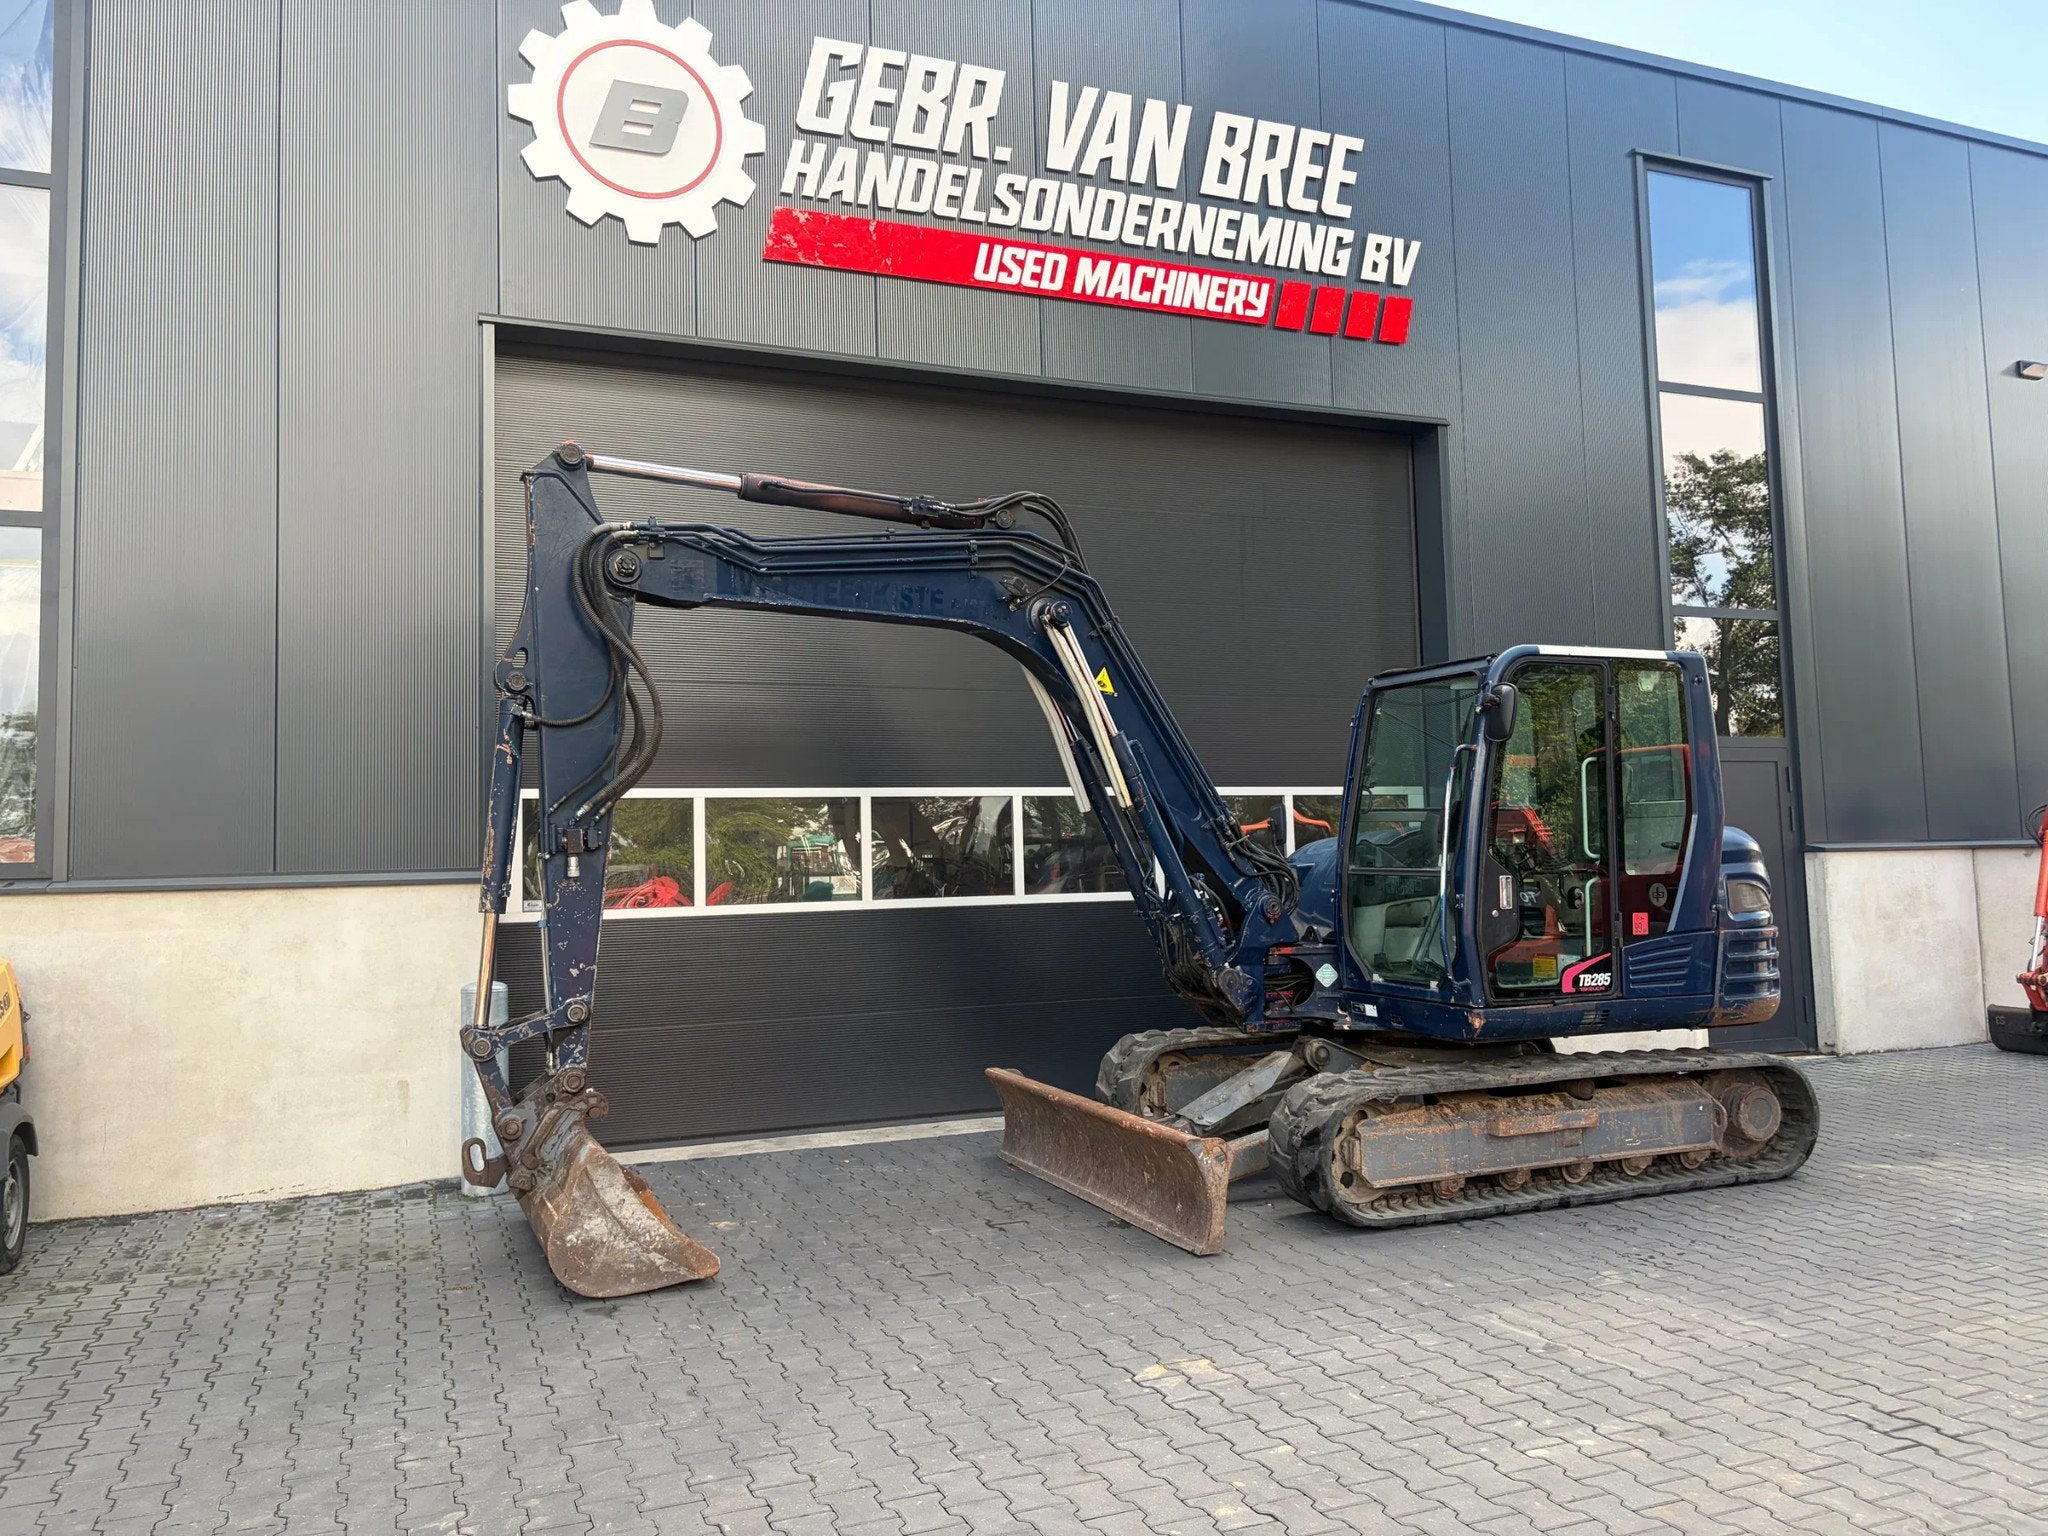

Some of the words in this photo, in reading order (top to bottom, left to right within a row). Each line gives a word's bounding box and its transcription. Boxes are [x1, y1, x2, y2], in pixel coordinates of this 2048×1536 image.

[589, 79, 689, 155] B
[796, 36, 1012, 161] GEBR.
[1046, 80, 1192, 190] VAN
[1200, 111, 1365, 218] BREE
[780, 139, 1354, 277] HANDELSONDERNEMING
[1360, 233, 1421, 286] BV
[973, 242, 1068, 291] USED
[1073, 257, 1270, 318] MACHINERY
[1579, 972, 1611, 987] TB285
